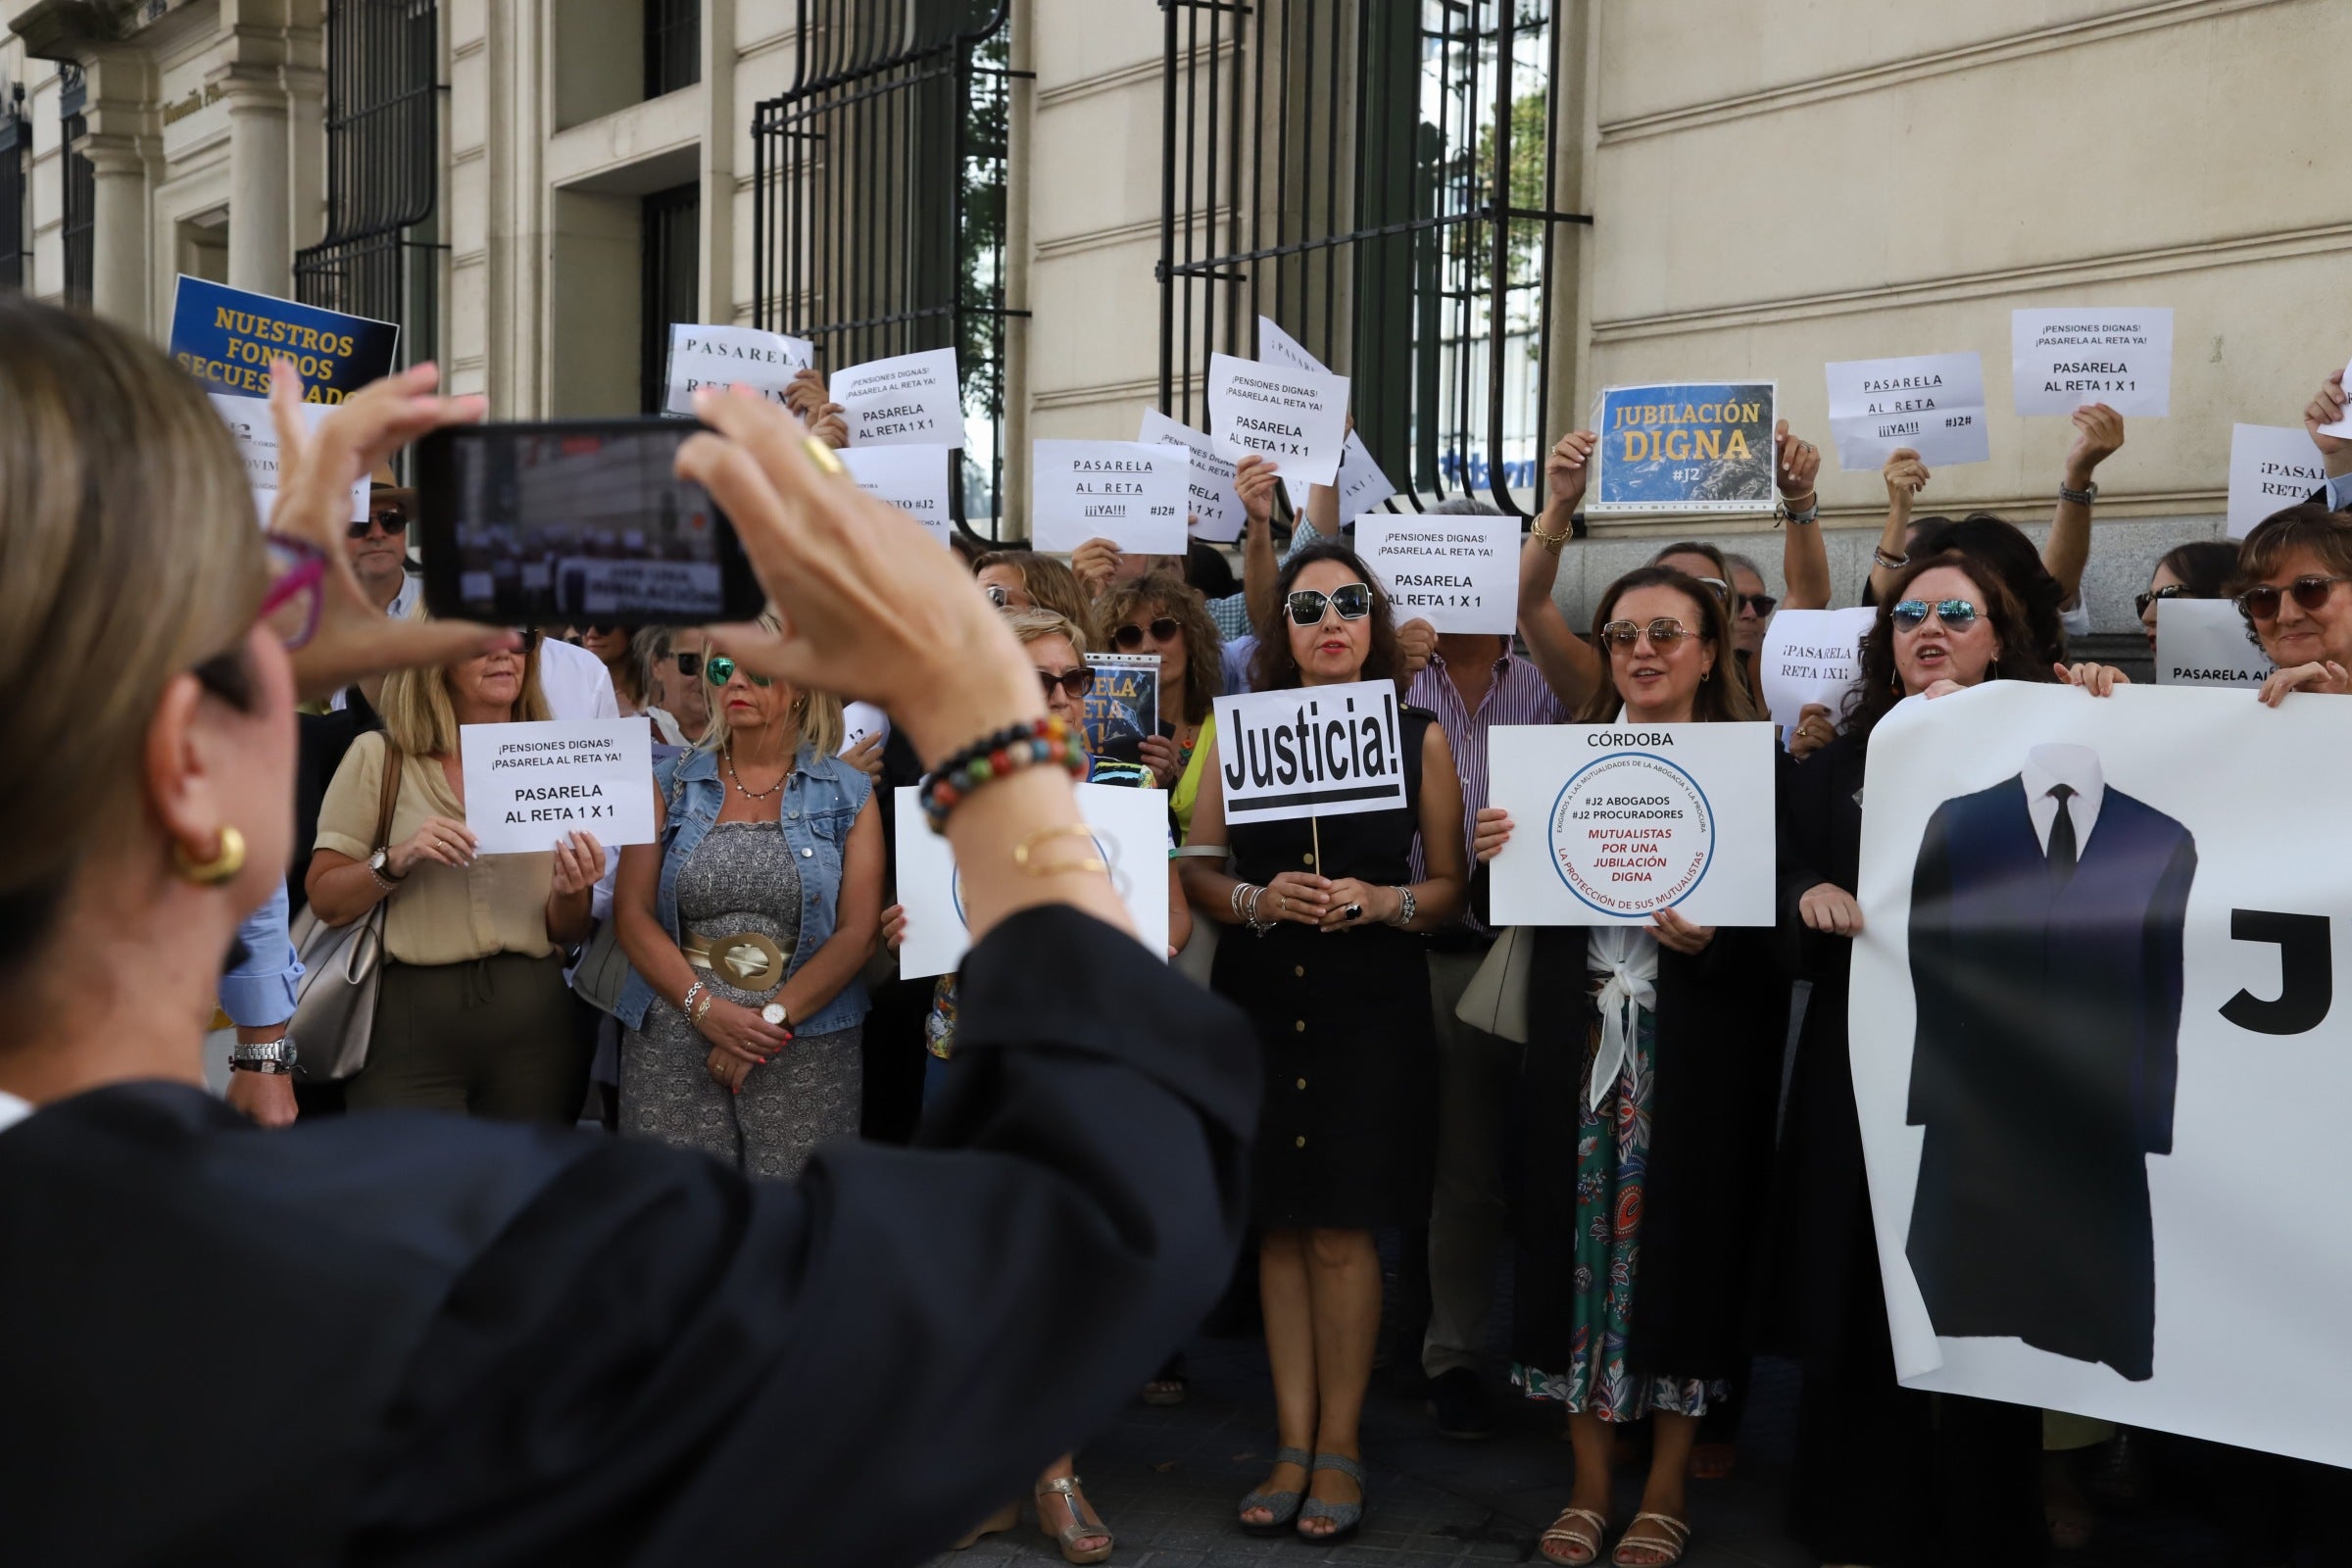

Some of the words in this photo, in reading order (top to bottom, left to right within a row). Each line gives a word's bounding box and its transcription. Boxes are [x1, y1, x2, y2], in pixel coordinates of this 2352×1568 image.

[215, 307, 354, 357] NUESTROS
[2042, 324, 2099, 334] ¡PENSIONES
[2035, 337, 2088, 347] ¡PASARELA
[2105, 336, 2131, 345] RETA
[2132, 336, 2147, 345] YA!
[686, 338, 808, 369] PASARELA
[2053, 363, 2128, 373] PASARELA
[851, 372, 896, 388] ¡PENSIONES
[898, 368, 930, 378] DIGNAS!
[1864, 374, 1942, 391] PASARELA
[2044, 381, 2062, 392] AL
[2066, 380, 2100, 391] RETA
[2104, 380, 2110, 391] 1
[2116, 380, 2125, 391] X
[2129, 380, 2135, 391] 1
[846, 386, 887, 400] ¡PASARELA
[902, 379, 922, 388] RETA
[923, 377, 936, 386] YA!
[1232, 376, 1280, 391] ¡PENSIONES
[1282, 385, 1318, 398] DIGNAS!
[1226, 387, 1268, 402] ¡PASARELA
[1270, 396, 1282, 405] AL
[1284, 398, 1306, 409] RETA
[1308, 403, 1322, 412] YA!
[1868, 403, 1884, 414] AL
[1895, 398, 1936, 411] RETA
[862, 404, 924, 421] PASARELA
[1613, 398, 1760, 429] JUBILACIÓN
[858, 429, 874, 439] AL
[876, 423, 906, 436] RETA
[909, 422, 914, 431] 1
[917, 419, 925, 430] X
[928, 418, 934, 428] 1
[1236, 416, 1302, 437] PASARELA
[1879, 421, 1919, 437] ¡¡¡YA!!!
[1945, 416, 1972, 428] #J2#
[1229, 432, 1242, 445] AL
[1244, 436, 1276, 451] RETA
[1280, 443, 1286, 453] 1
[1290, 444, 1298, 455] X
[1303, 446, 1309, 457] 1
[1623, 429, 1752, 462] DIGNA
[1073, 460, 1152, 471] PASARELA
[1208, 466, 1229, 478] RETA
[1672, 467, 1700, 483] #J2
[1076, 482, 1094, 493] AL
[1104, 483, 1144, 493] RETA
[1189, 484, 1221, 502] RELA
[2262, 482, 2313, 499] RETA
[915, 500, 934, 510] #J2
[1085, 505, 1126, 516] ¡¡¡YA!!!
[1151, 506, 1175, 515] #J2#
[1385, 533, 1444, 543] ¡PENSIONES
[1446, 534, 1487, 543] DIGNAS!
[1378, 546, 1432, 556] ¡PASARELA
[1435, 547, 1446, 556] AL
[1449, 548, 1475, 557] RETA
[1396, 574, 1473, 588] PASARELA
[1388, 594, 1403, 606] AL
[1407, 594, 1445, 607] RETA
[1448, 595, 1454, 607] 1
[1460, 596, 1470, 607] X
[1475, 596, 1481, 608] 1
[1783, 644, 1851, 660] ¡PASARELA
[1781, 664, 1818, 679] RETA
[2173, 667, 2248, 681] PASARELA
[1225, 694, 1397, 791] Justicia!
[1587, 730, 1674, 747] CÓRDOBA
[499, 741, 565, 756] ¡PENSIONES
[568, 739, 613, 750] DIGNAS!
[491, 757, 554, 770] ¡PASARELA
[557, 756, 570, 764] AL
[573, 754, 602, 763] RETA
[605, 753, 621, 761] YA!
[514, 784, 603, 802] PASARELA
[1557, 802, 1570, 833] EXIGIMOS
[1571, 783, 1583, 795] LAS
[1581, 760, 1631, 785] MUTUALIDADES
[1688, 792, 1695, 801] LA
[1693, 801, 1706, 833] PROCURA
[1585, 797, 1603, 807] #J2
[1607, 796, 1670, 806] ABOGADOS
[505, 810, 526, 824] AL
[531, 808, 573, 821] RETA
[578, 807, 585, 818] 1
[591, 806, 602, 818] X
[607, 805, 613, 816] 1
[1572, 810, 1590, 819] #J2
[1593, 809, 1684, 819] PROCURADORES
[1588, 829, 1672, 839] MUTUALISTAS
[1601, 844, 1627, 853] POR
[1631, 844, 1658, 853] UNA
[1593, 855, 1667, 867] JUBILACIÓN
[1558, 848, 1568, 861] LA
[1564, 861, 1616, 906] PROTECCIÓN
[1618, 901, 1632, 909] DE
[1635, 900, 1654, 909] SUS
[1656, 852, 1704, 905] MUTUALISTAS
[1611, 872, 1652, 882] DIGNA
